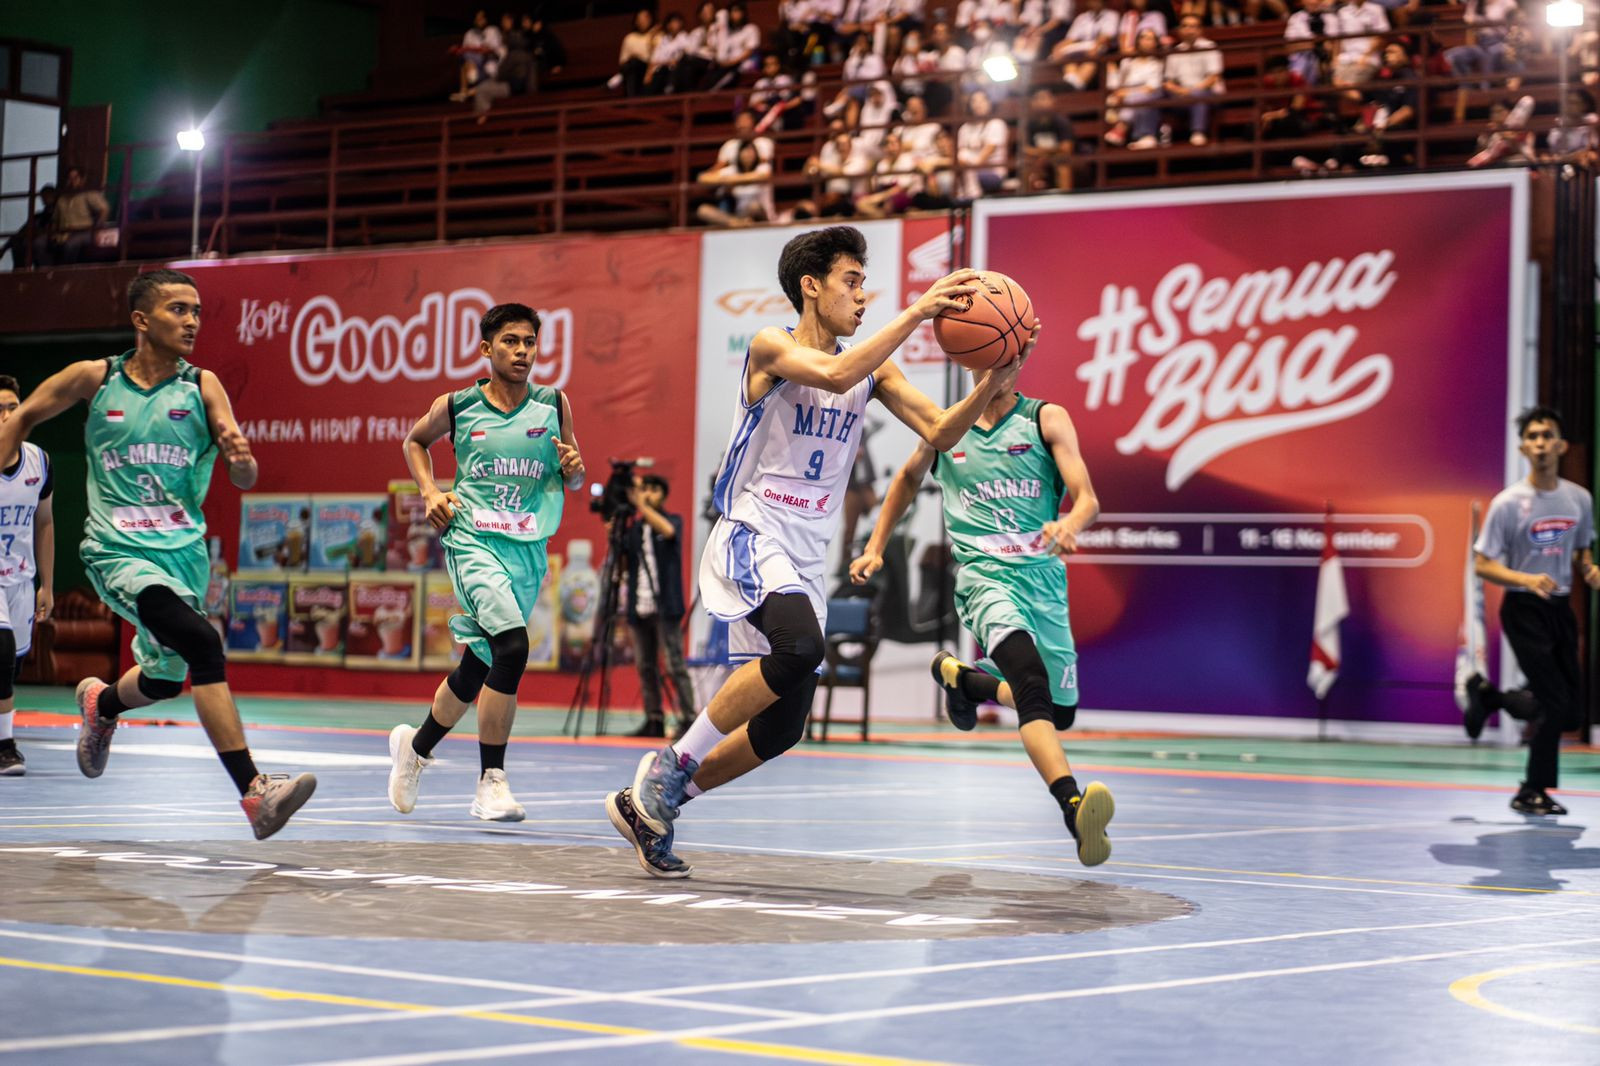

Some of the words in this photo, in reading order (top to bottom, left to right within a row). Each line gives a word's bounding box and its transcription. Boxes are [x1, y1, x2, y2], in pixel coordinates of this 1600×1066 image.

[1077, 250, 1398, 410] #Semua
[1115, 325, 1393, 491] Bisa
[310, 415, 363, 443] HIDUP
[804, 449, 825, 480] 9
[493, 484, 522, 512] 34
[763, 488, 782, 502] One
[119, 519, 137, 529] One
[475, 519, 491, 529] One
[991, 507, 1021, 533] 13
[1, 534, 15, 556] 7
[1296, 528, 1399, 550] Noember
[1060, 663, 1077, 689] 13
